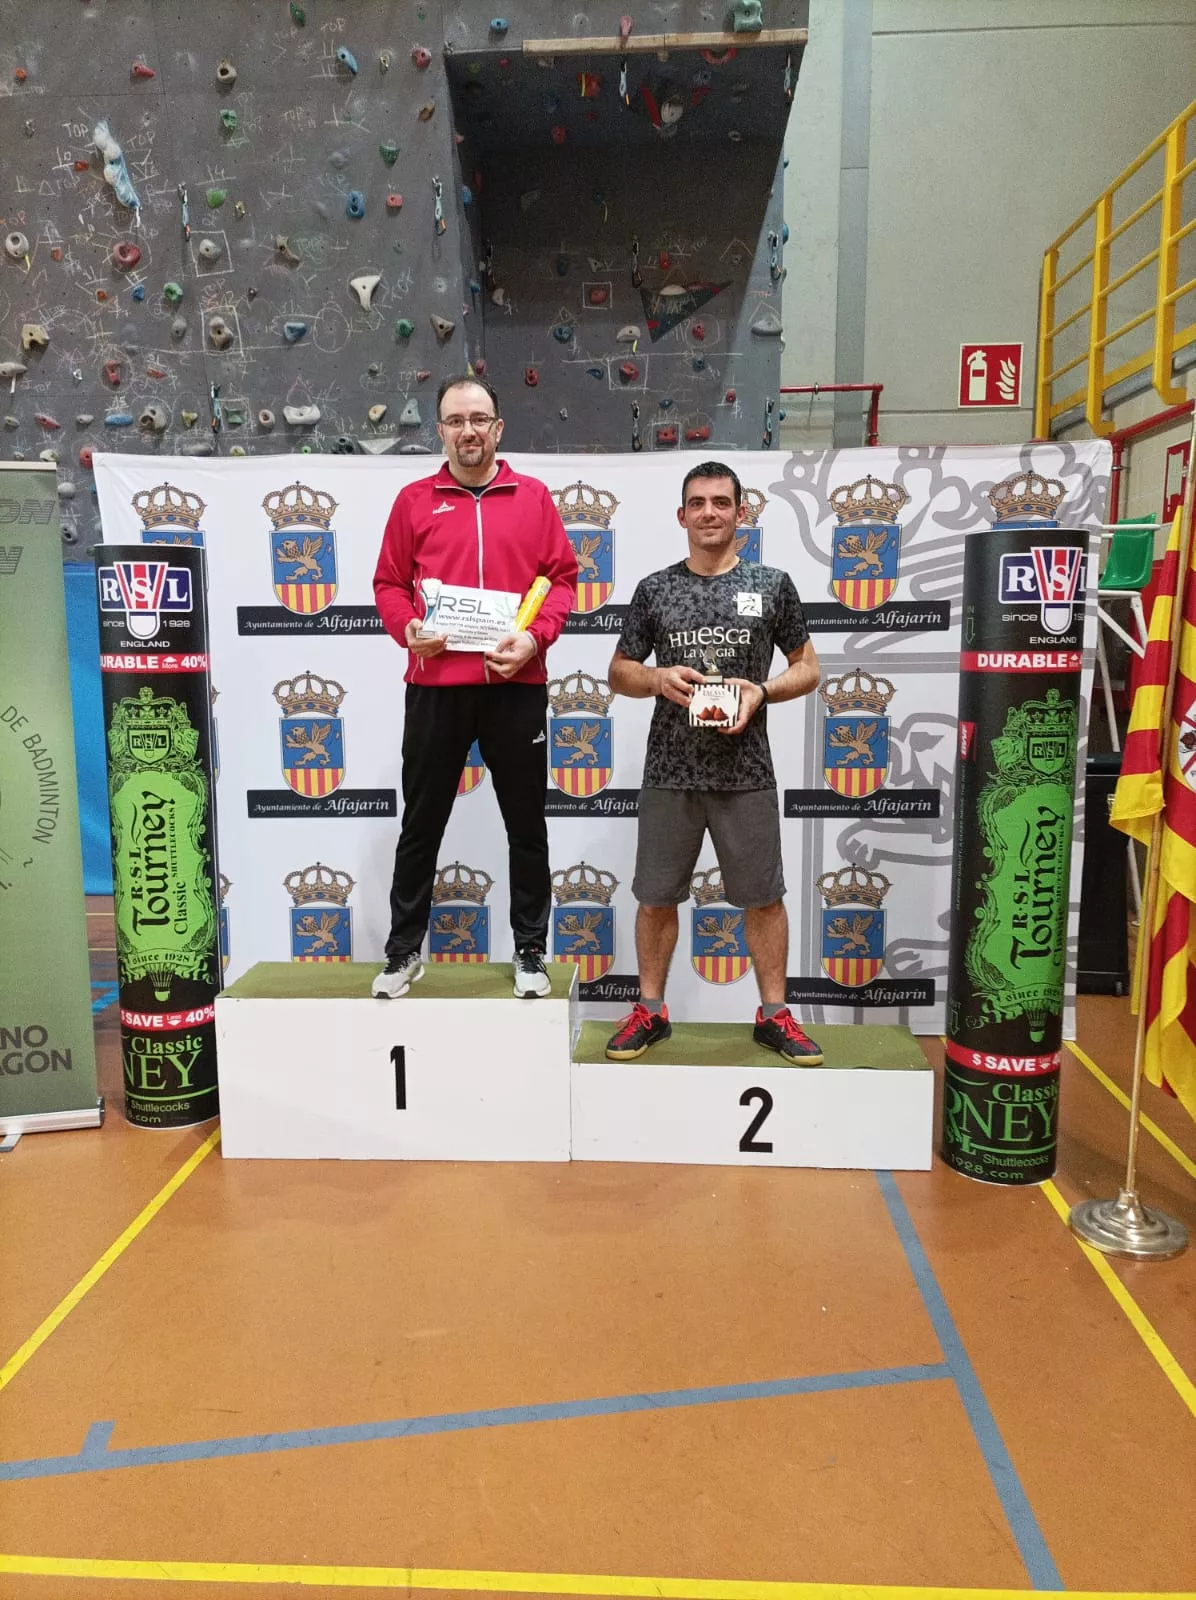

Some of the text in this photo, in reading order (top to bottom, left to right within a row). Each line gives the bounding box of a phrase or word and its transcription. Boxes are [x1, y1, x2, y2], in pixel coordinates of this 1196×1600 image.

[100, 577, 188, 603] RSL
[437, 595, 491, 616] RSL
[103, 619, 191, 628] since 1928
[244, 614, 383, 633] Ayuntamiento de Alfajarín
[578, 618, 588, 627] de
[859, 617, 869, 625] de
[872, 611, 942, 629] Alfajarín
[1001, 612, 1038, 623] since
[120, 640, 170, 648] ENGLAND
[1029, 636, 1077, 645] ENGLAND
[181, 654, 207, 669] 40%
[977, 653, 1067, 669] DURABLE
[1, 705, 60, 844] DE BADMINTON
[254, 797, 389, 815] Ayuntamiento de Alfajarín
[578, 802, 588, 811] de
[791, 798, 931, 816] Ayuntamiento de Alfajarín
[131, 791, 176, 936] Tourney
[1010, 806, 1066, 970] Tourney
[173, 881, 189, 935] Classic
[789, 988, 927, 1002] Ayuntamiento de Alfajarín
[126, 1013, 163, 1027] SAVE
[185, 1006, 215, 1023] 40%
[131, 1034, 203, 1055] Classic
[985, 1055, 1036, 1072] SAVE
[389, 1045, 407, 1110] 1
[131, 1100, 190, 1114] Shuttlecocks
[739, 1086, 774, 1153] 2
